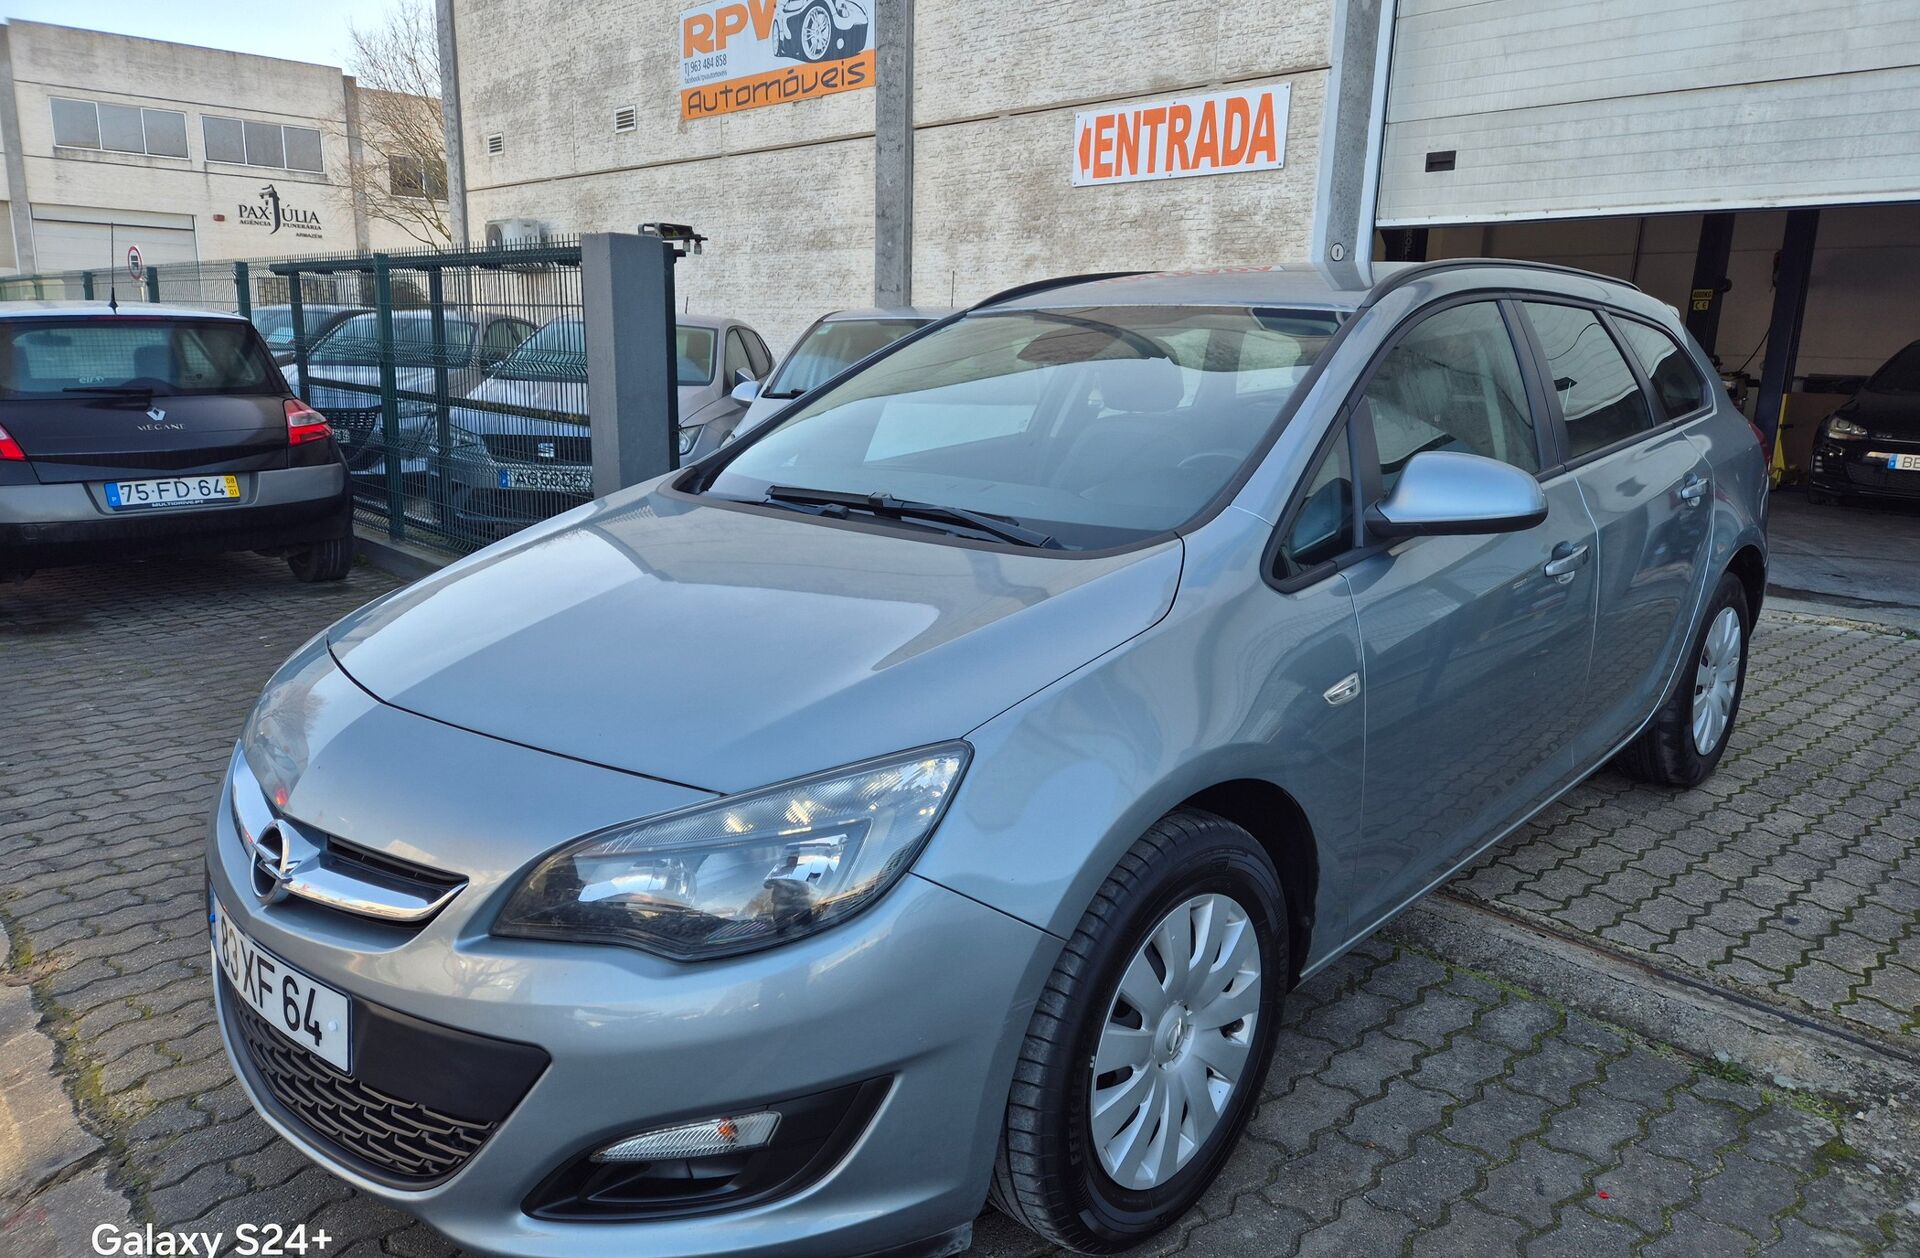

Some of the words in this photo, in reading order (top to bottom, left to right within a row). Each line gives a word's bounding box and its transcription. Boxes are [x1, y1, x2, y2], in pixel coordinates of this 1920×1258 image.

[684, 0, 776, 59] RPV
[716, 53, 728, 67] 858
[688, 61, 866, 115] Automóveis
[1092, 92, 1277, 179] ENTRADA
[239, 219, 272, 227] AGÊNCIA
[282, 222, 322, 231] FUNERÁRIA
